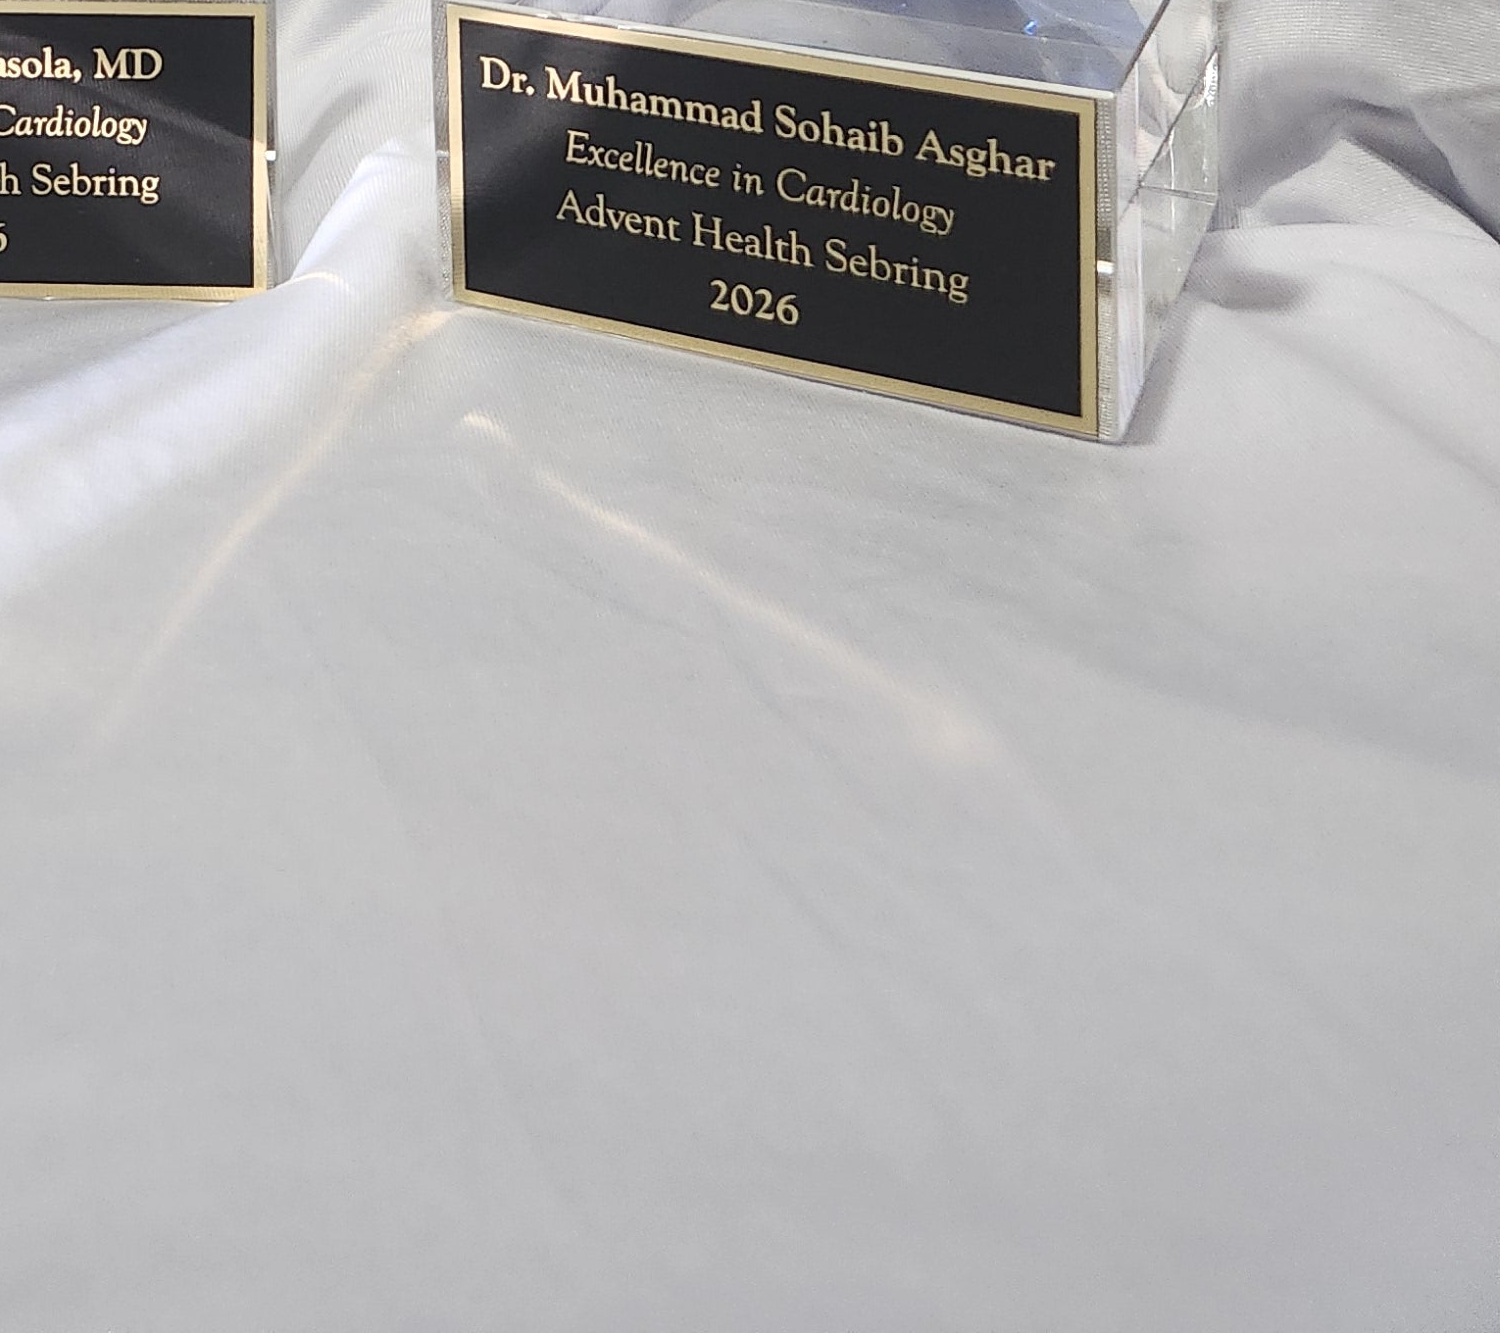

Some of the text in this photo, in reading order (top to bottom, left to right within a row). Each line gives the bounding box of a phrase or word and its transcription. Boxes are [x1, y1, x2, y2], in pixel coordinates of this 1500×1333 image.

[93, 48, 163, 80] MD
[479, 55, 1056, 181] Dr. Muhammad Sohaib Asghar
[31, 162, 160, 205] Sebring
[566, 129, 955, 235] Excellence in Cardiology
[556, 189, 969, 304] Advent Health Sebring
[710, 279, 799, 325] 2026
